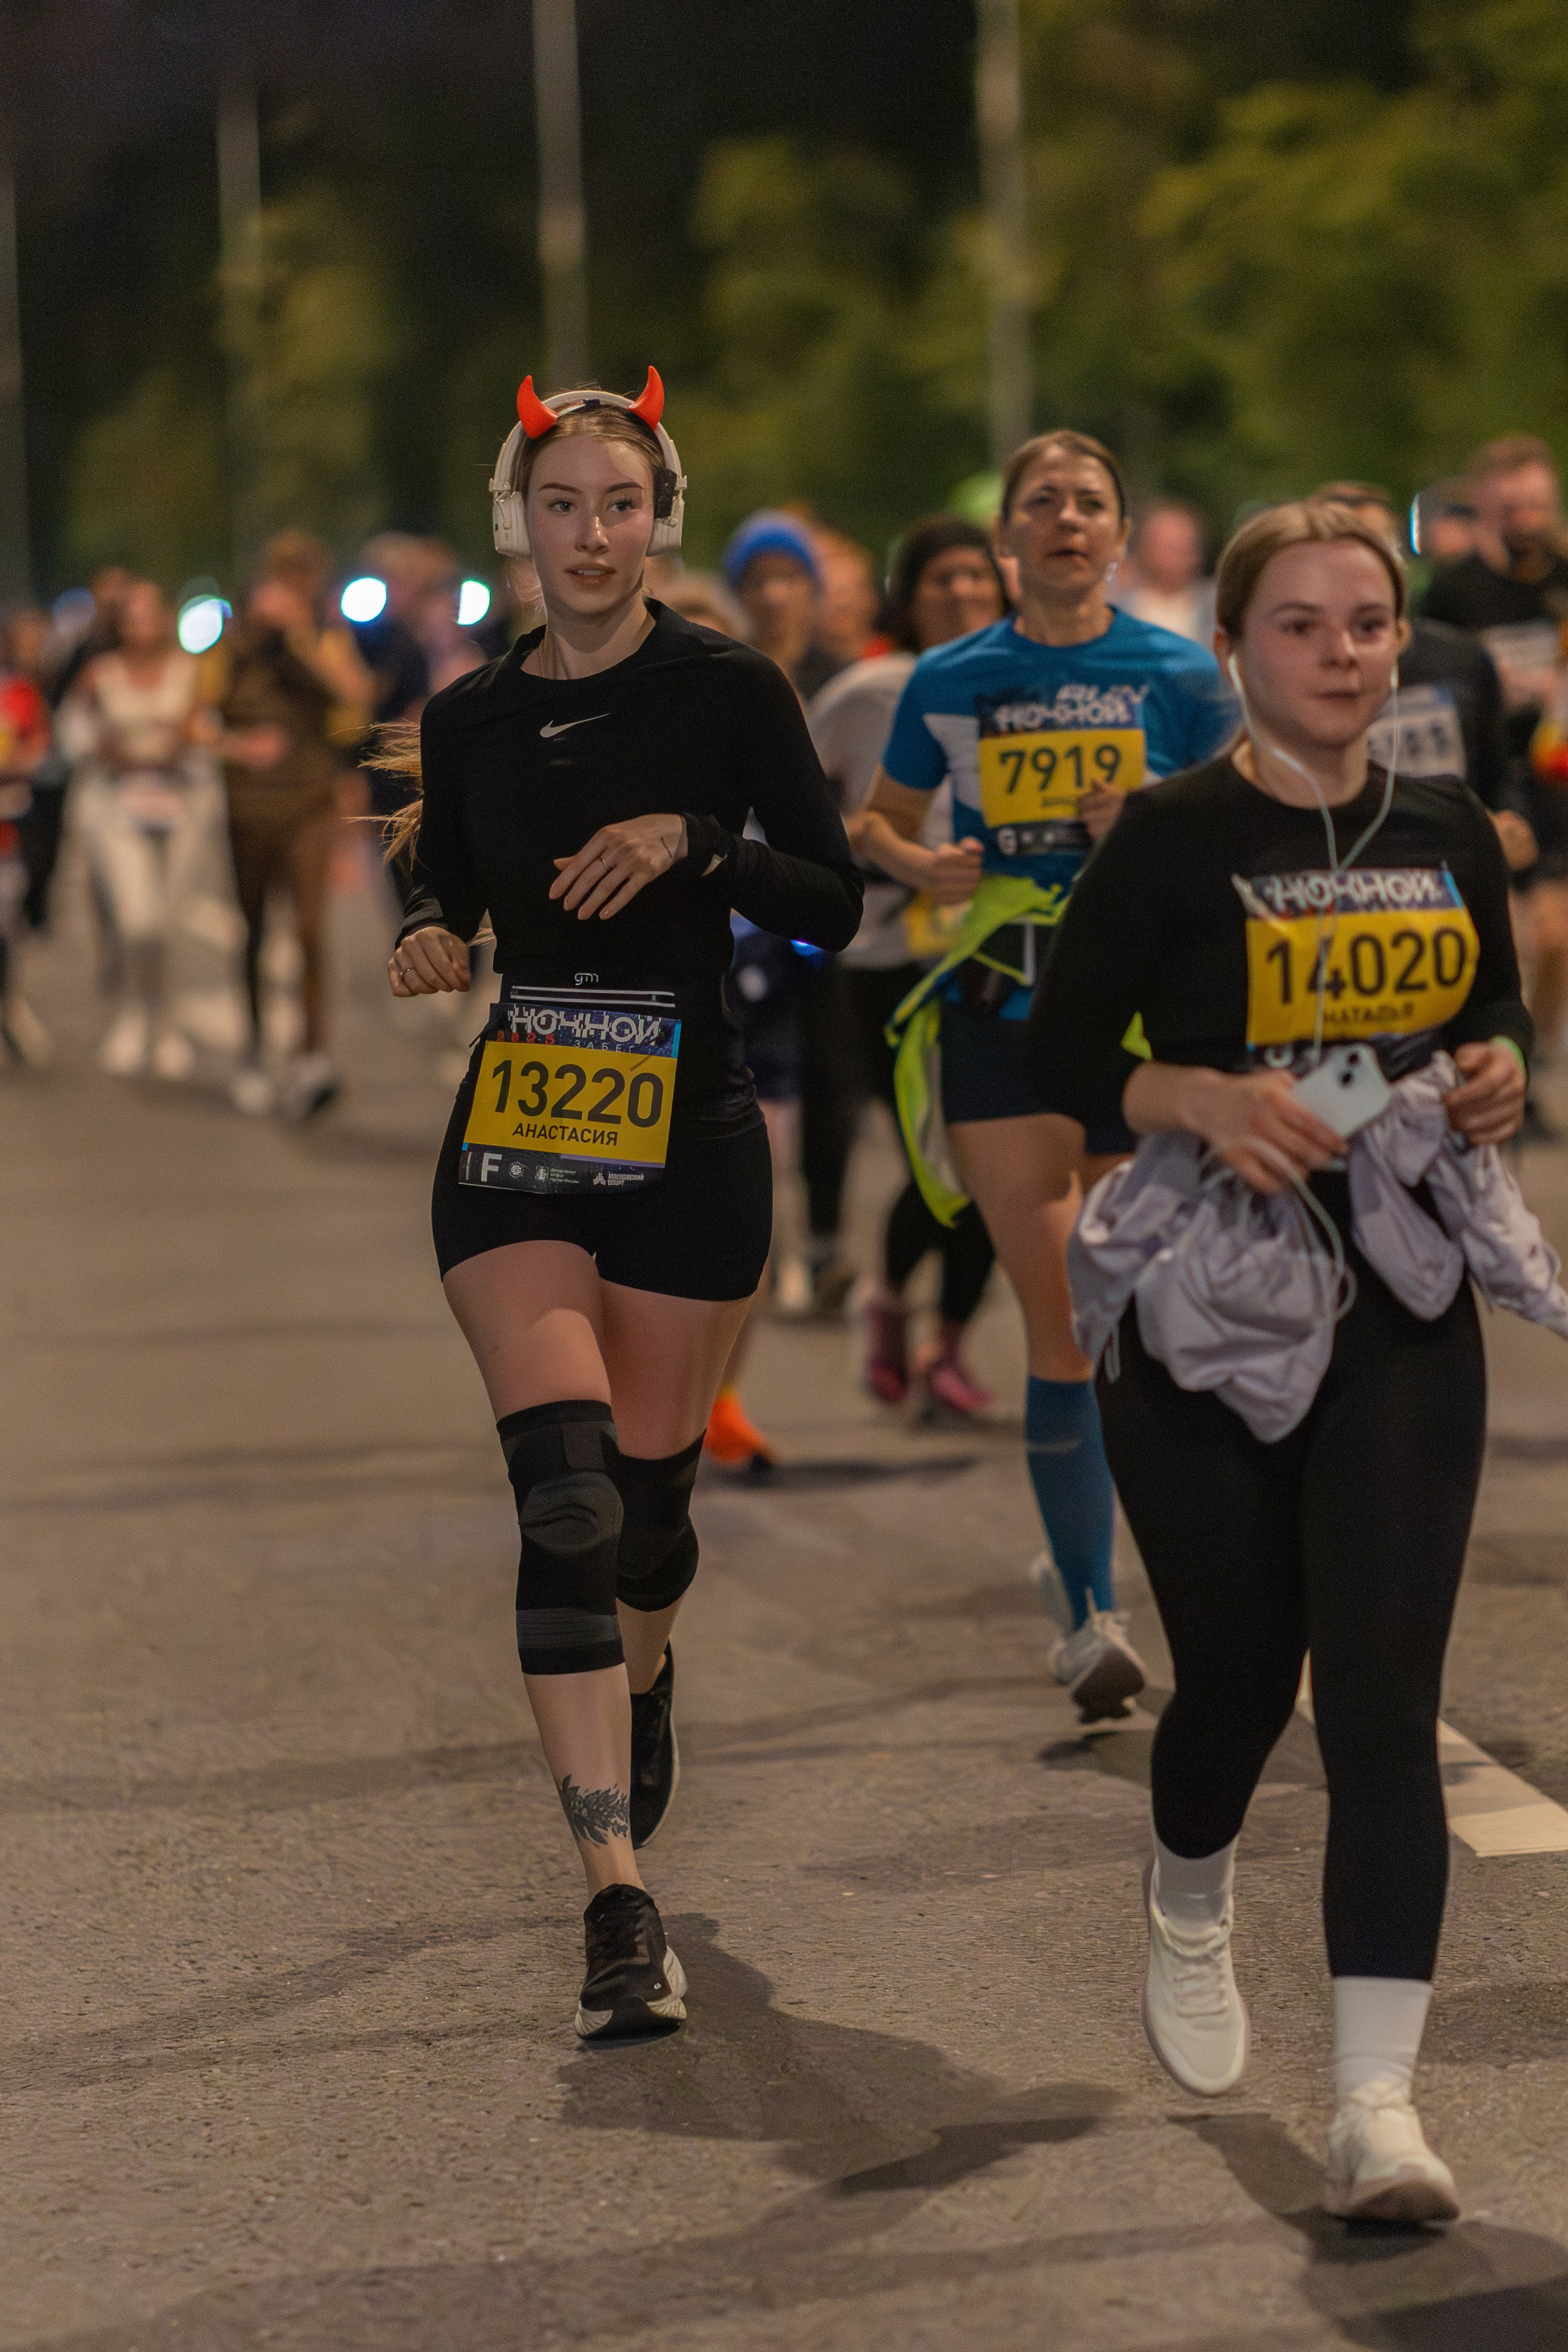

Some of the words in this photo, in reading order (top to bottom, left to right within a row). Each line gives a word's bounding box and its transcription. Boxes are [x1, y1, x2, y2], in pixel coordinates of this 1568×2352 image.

[1000, 743, 1121, 794] 7919
[1266, 926, 1468, 1005] 14020
[508, 1003, 662, 1046] НОЧНОЙ
[575, 1039, 635, 1054] ЗАБЕГ
[491, 1059, 664, 1128] 13220
[512, 1122, 619, 1147] АНАСТАСИЯ
[481, 1152, 502, 1182] F
